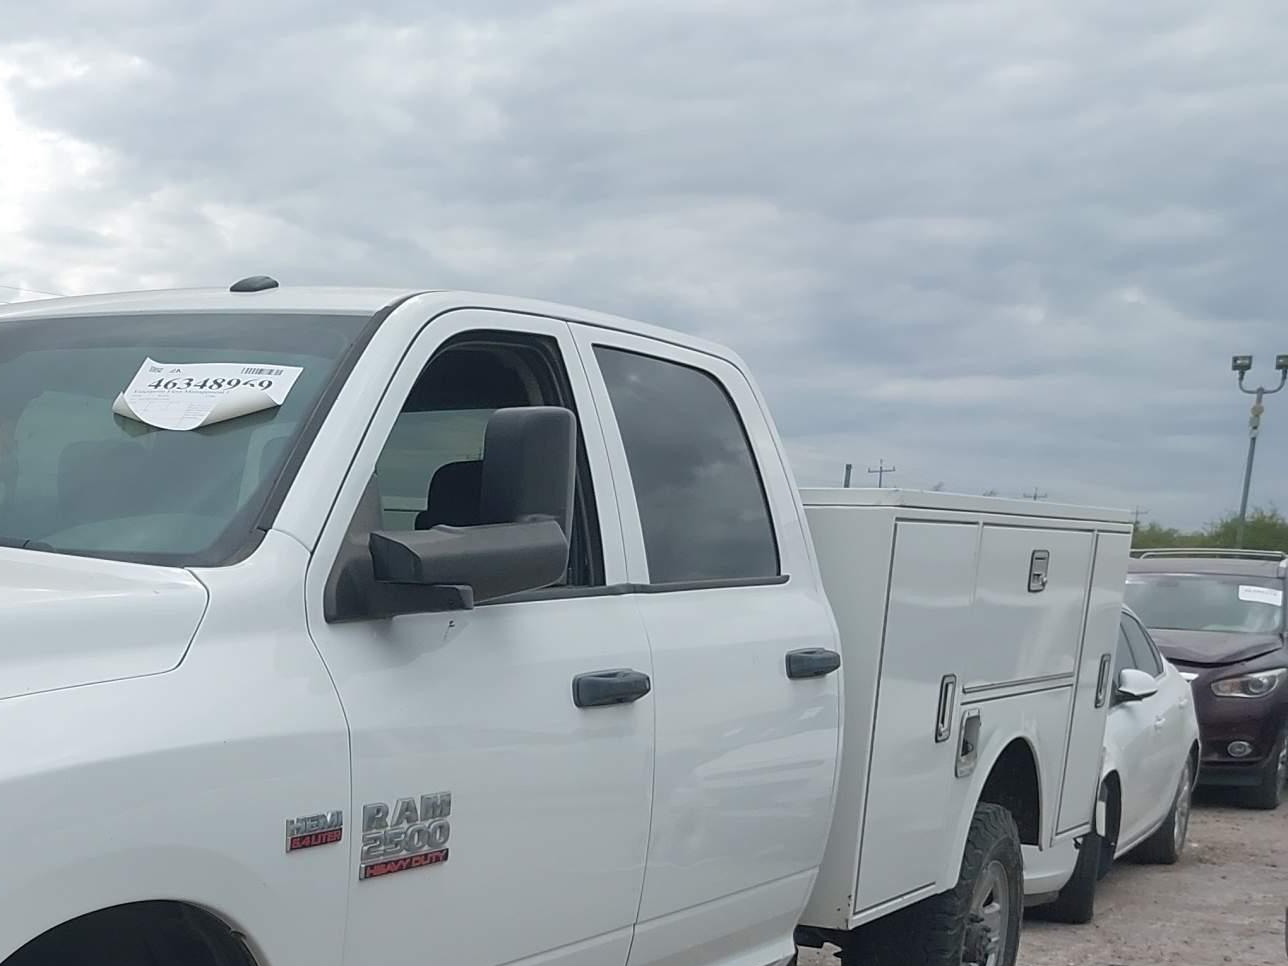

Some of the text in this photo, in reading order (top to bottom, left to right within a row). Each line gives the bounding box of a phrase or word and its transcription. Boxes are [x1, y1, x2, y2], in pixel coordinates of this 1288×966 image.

[286, 811, 343, 836] HEMI
[362, 791, 451, 833] RAM
[310, 831, 342, 847] LITER
[361, 819, 451, 862] 2500
[366, 851, 448, 878] HEAVY DUTY
